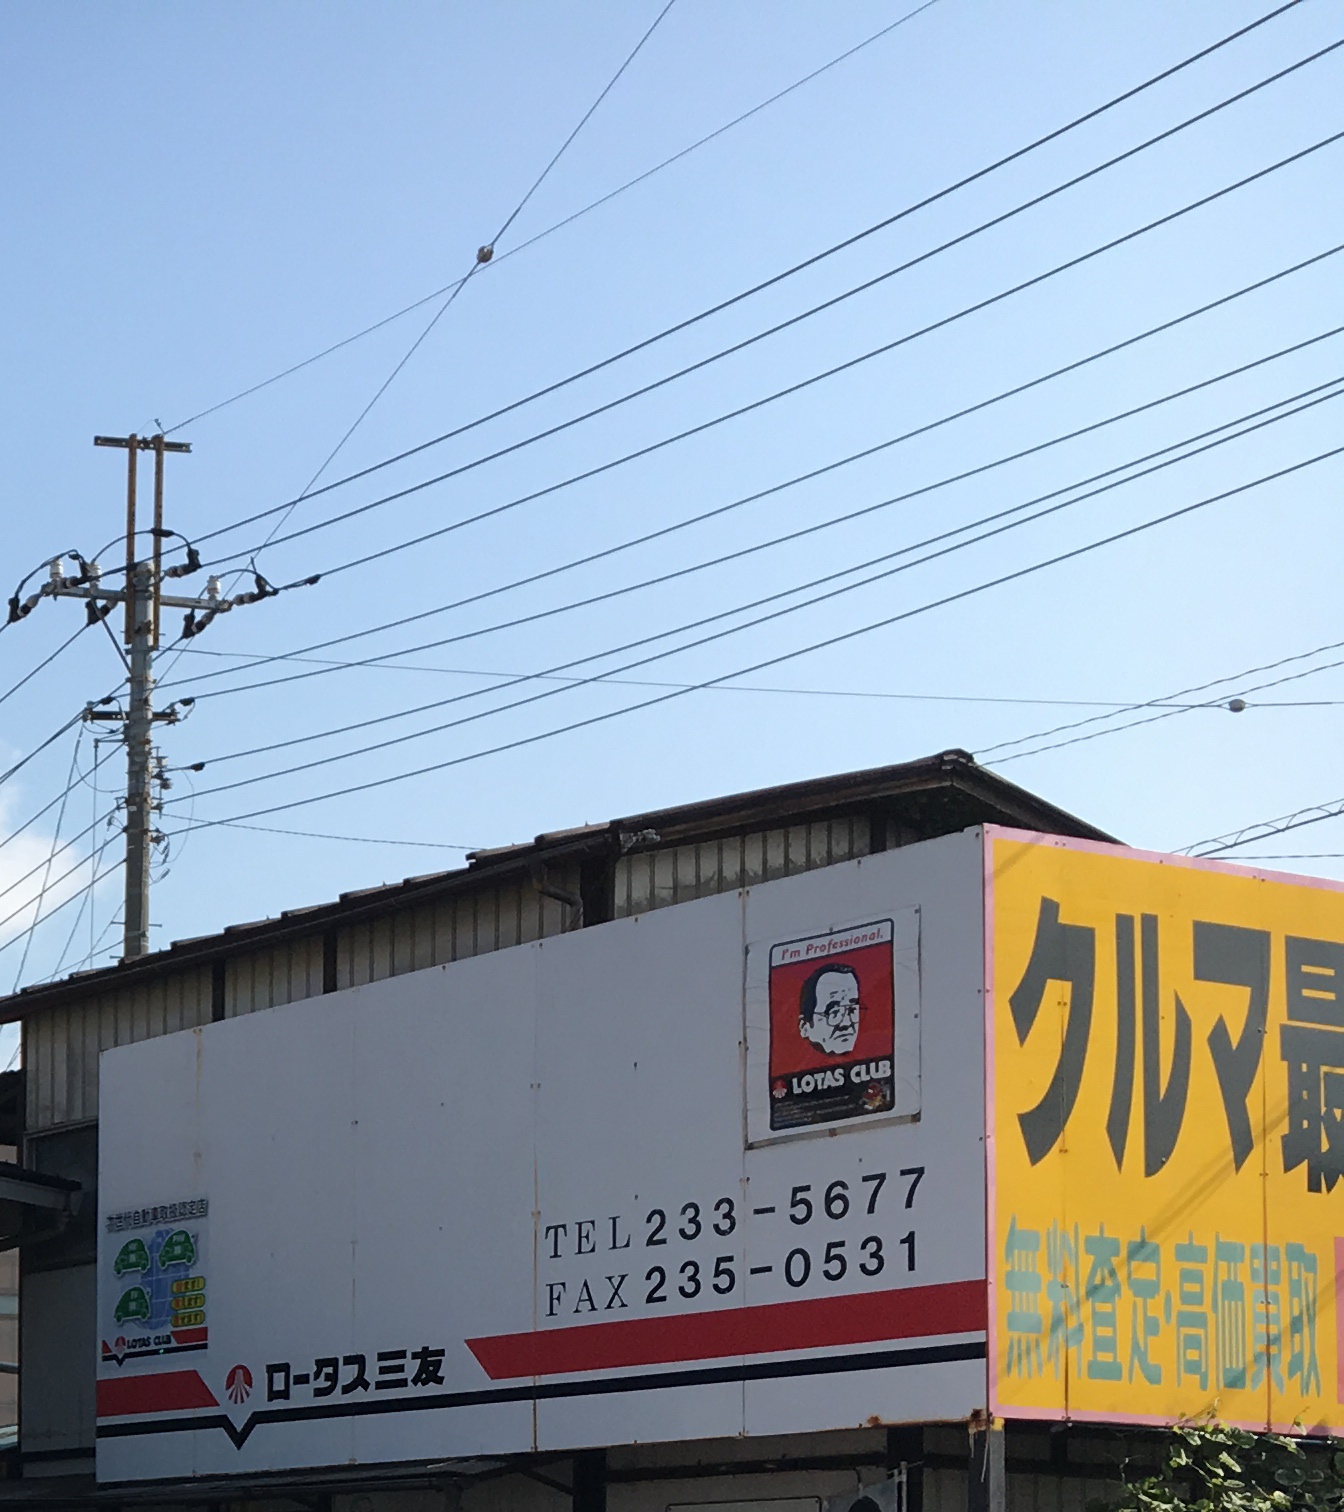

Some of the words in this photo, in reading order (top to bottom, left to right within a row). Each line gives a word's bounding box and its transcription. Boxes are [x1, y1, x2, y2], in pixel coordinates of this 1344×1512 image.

[781, 948, 801, 961] I'm
[805, 928, 883, 956] Professional.
[791, 1068, 845, 1095] LOTAS
[849, 1060, 892, 1084] CLUB
[544, 1215, 632, 1259] TEL
[645, 1167, 926, 1248] 233-5677
[545, 1273, 629, 1317] FAX
[644, 1230, 917, 1305] 235-0531
[1004, 1212, 1322, 1399] 無料査定・高価買取
[126, 1336, 152, 1350] LOTAS
[153, 1333, 172, 1346] CLUB
[266, 1346, 446, 1402] ロータス三友
